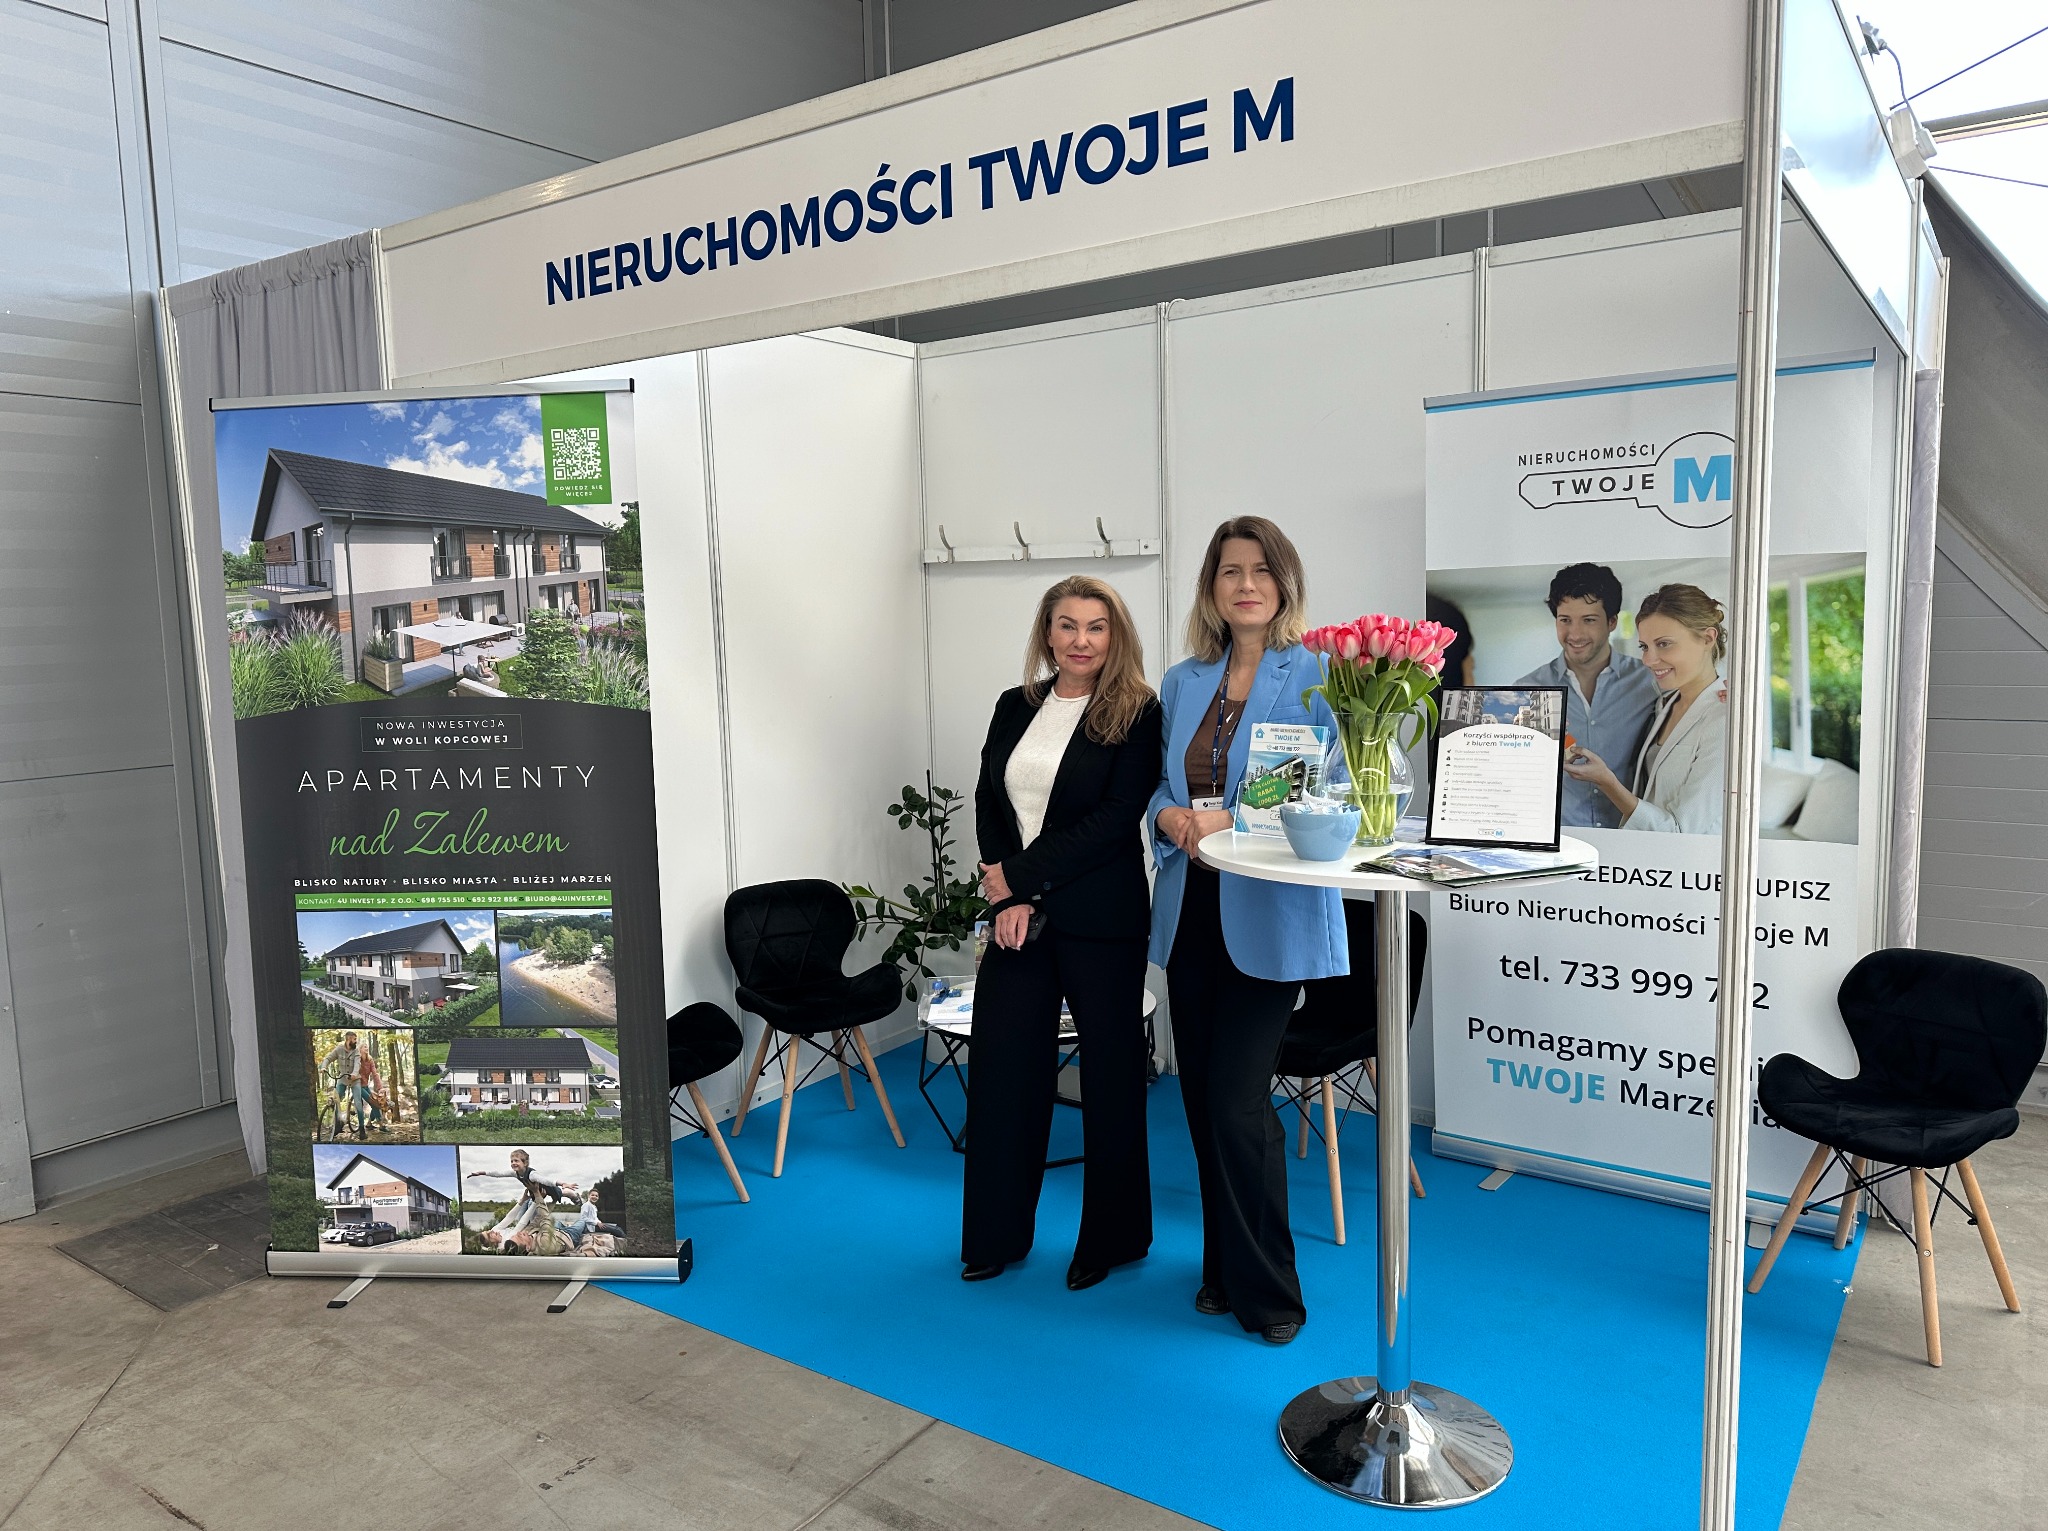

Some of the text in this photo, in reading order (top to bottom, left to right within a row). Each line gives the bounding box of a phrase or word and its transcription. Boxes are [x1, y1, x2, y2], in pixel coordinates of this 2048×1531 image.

[545, 77, 1295, 306] NIERUCHOMOŚCI TWOJE M
[1518, 442, 1655, 466] NIERUCHOMOŚCI
[1552, 454, 1732, 503] TWOJE M
[376, 719, 505, 730] NOWA INWESTYCJA
[1464, 732, 1535, 741] Korzyści współpracy
[375, 735, 508, 746] W WOLI KOPCOWEJ
[1499, 740, 1522, 748] Twoje
[298, 765, 595, 793] APARTAMENTY
[1257, 786, 1276, 798] RABAT
[329, 807, 570, 856] nad Zalewem
[294, 873, 612, 887] BLISKO NATURY BLISKO MIASTA BLIŻEJ MARZEŃ
[1756, 878, 1831, 901] UPISZ
[525, 895, 608, 903] BIURO@4UINVEST.PL
[1450, 893, 1510, 915] Biuro
[1518, 899, 1706, 935] Nieruchomości
[1804, 926, 1829, 947] M
[1500, 954, 1770, 1009] tel. 733 999 72
[1468, 1017, 1647, 1072] Pomagamy
[1487, 1058, 1605, 1104] TWOJE
